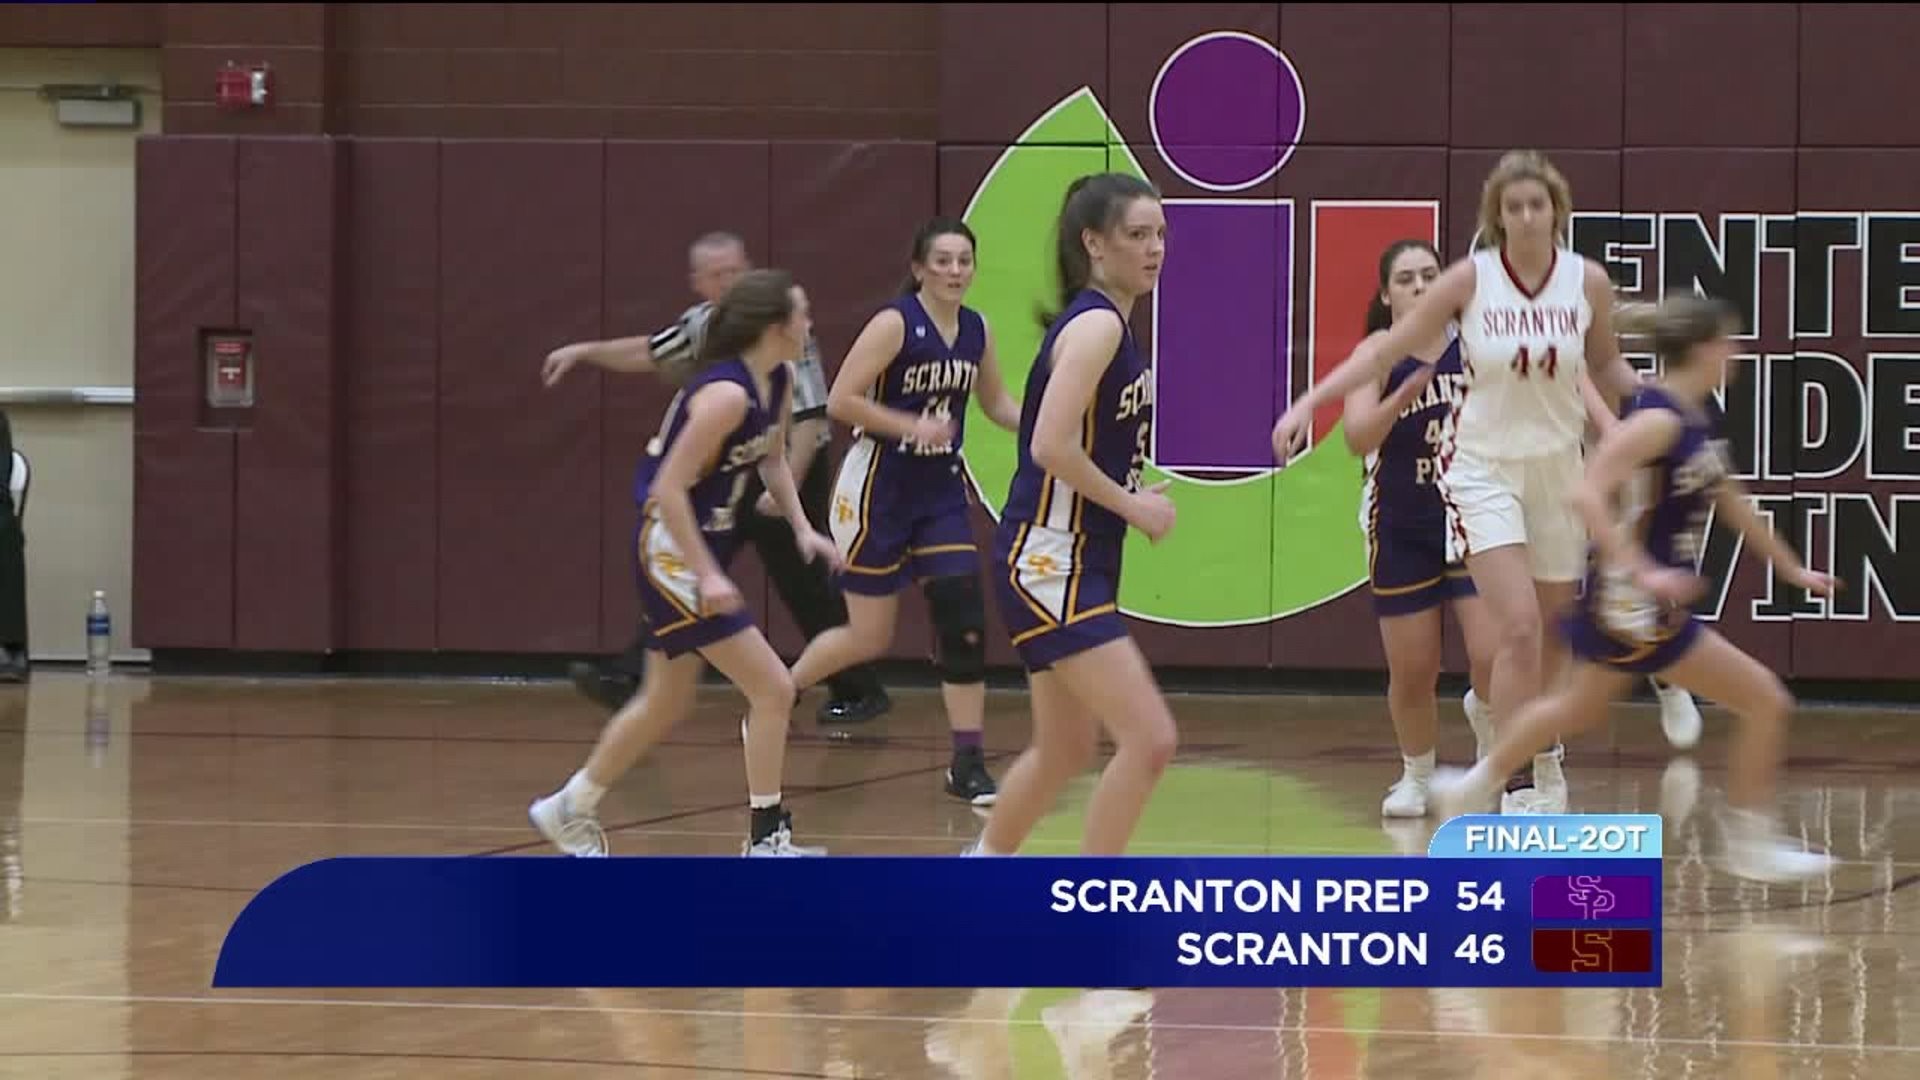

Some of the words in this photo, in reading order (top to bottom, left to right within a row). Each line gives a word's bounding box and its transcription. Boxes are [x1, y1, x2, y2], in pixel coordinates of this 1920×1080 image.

[1470, 211, 1920, 339] ENTE
[1483, 305, 1581, 338] SCRANTON
[1510, 345, 1558, 382] 44
